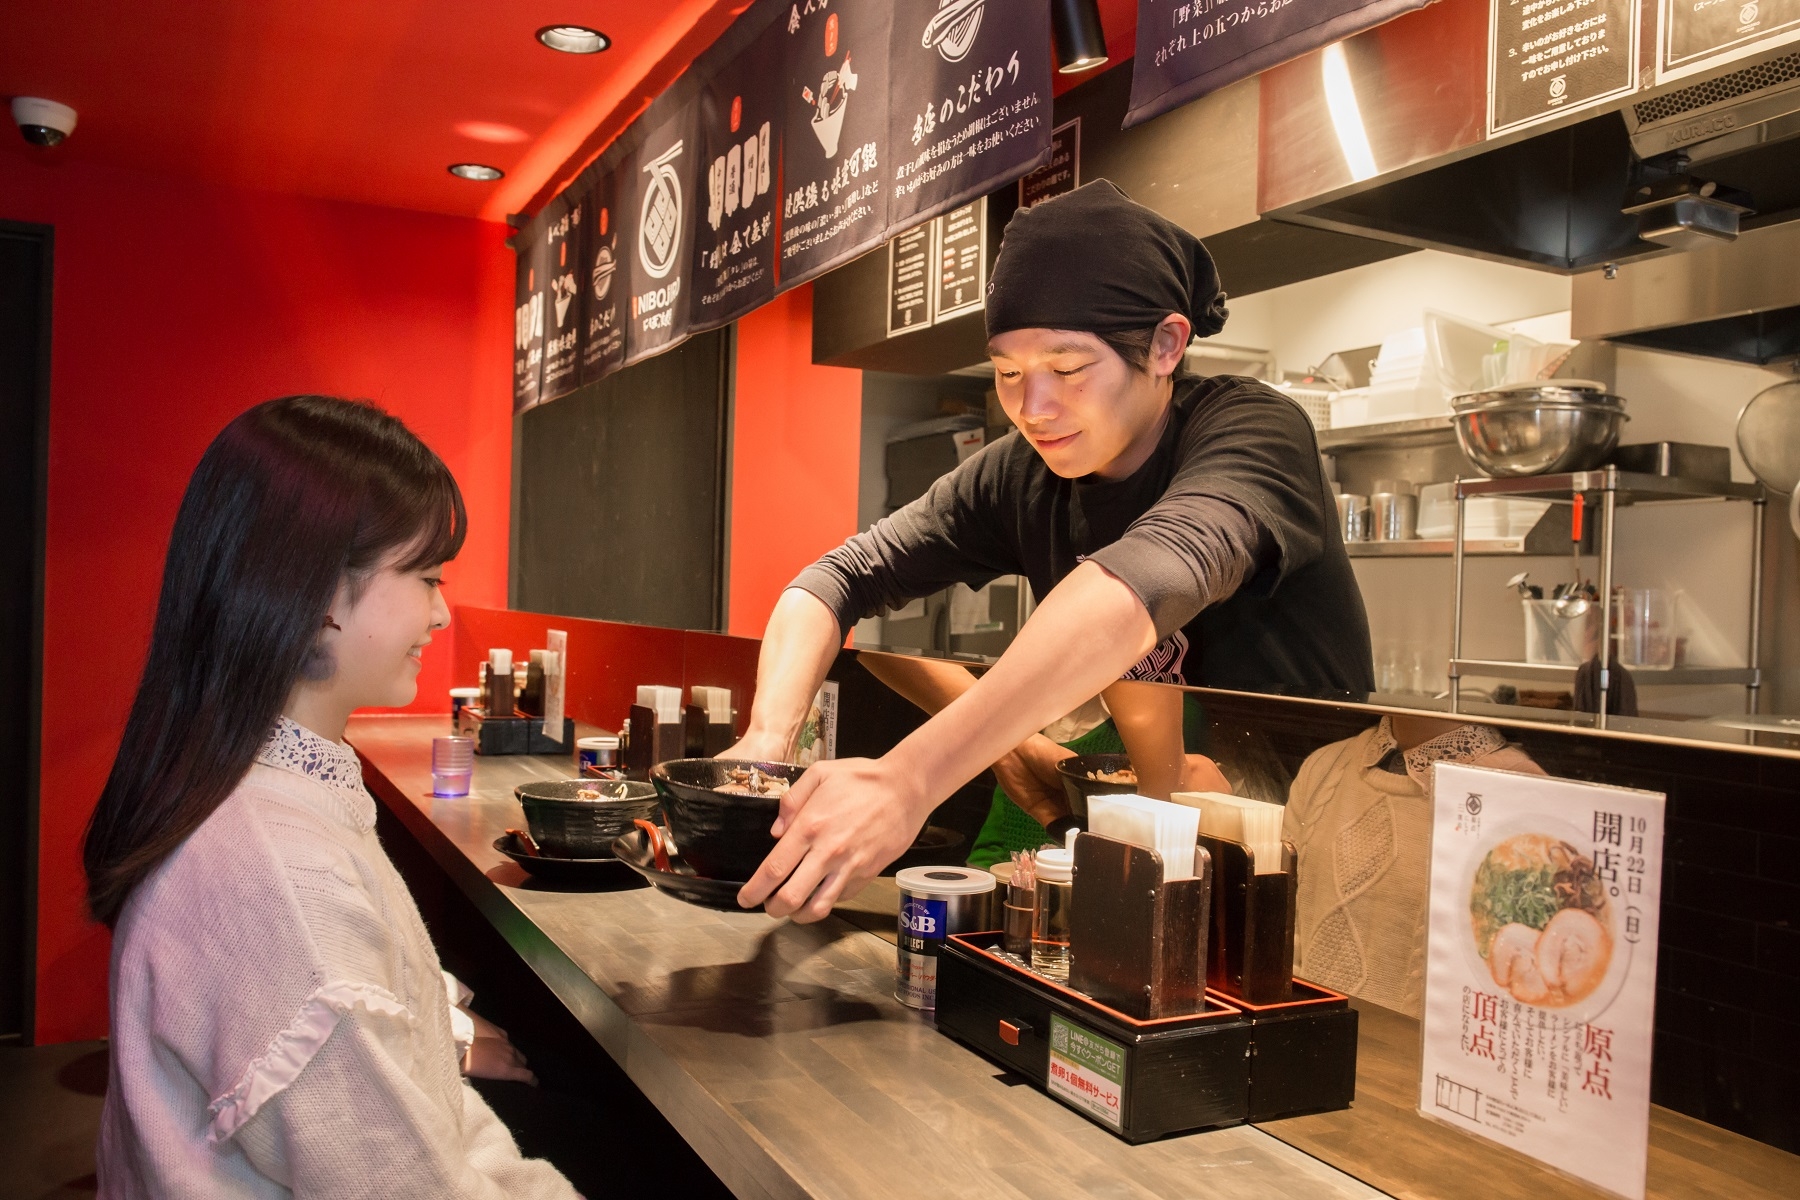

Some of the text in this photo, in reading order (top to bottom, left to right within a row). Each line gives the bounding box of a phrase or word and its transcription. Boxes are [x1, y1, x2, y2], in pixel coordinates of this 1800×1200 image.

[1508, 13, 1607, 58] 3. 辛いのがお好きな方には
[1521, 45, 1610, 82] すのでお申し付け下さい。
[911, 49, 1020, 147] 当店のこだわり
[1592, 810, 1622, 898] 開店。
[900, 911, 936, 933] S&B
[904, 935, 924, 950] LECT
[1469, 990, 1499, 1062] 頂点
[1070, 1041, 1121, 1075] 今すぐクーポンGET
[1581, 1023, 1615, 1101] 原点
[1050, 1061, 1119, 1110] 煮卵1個無料サービス
